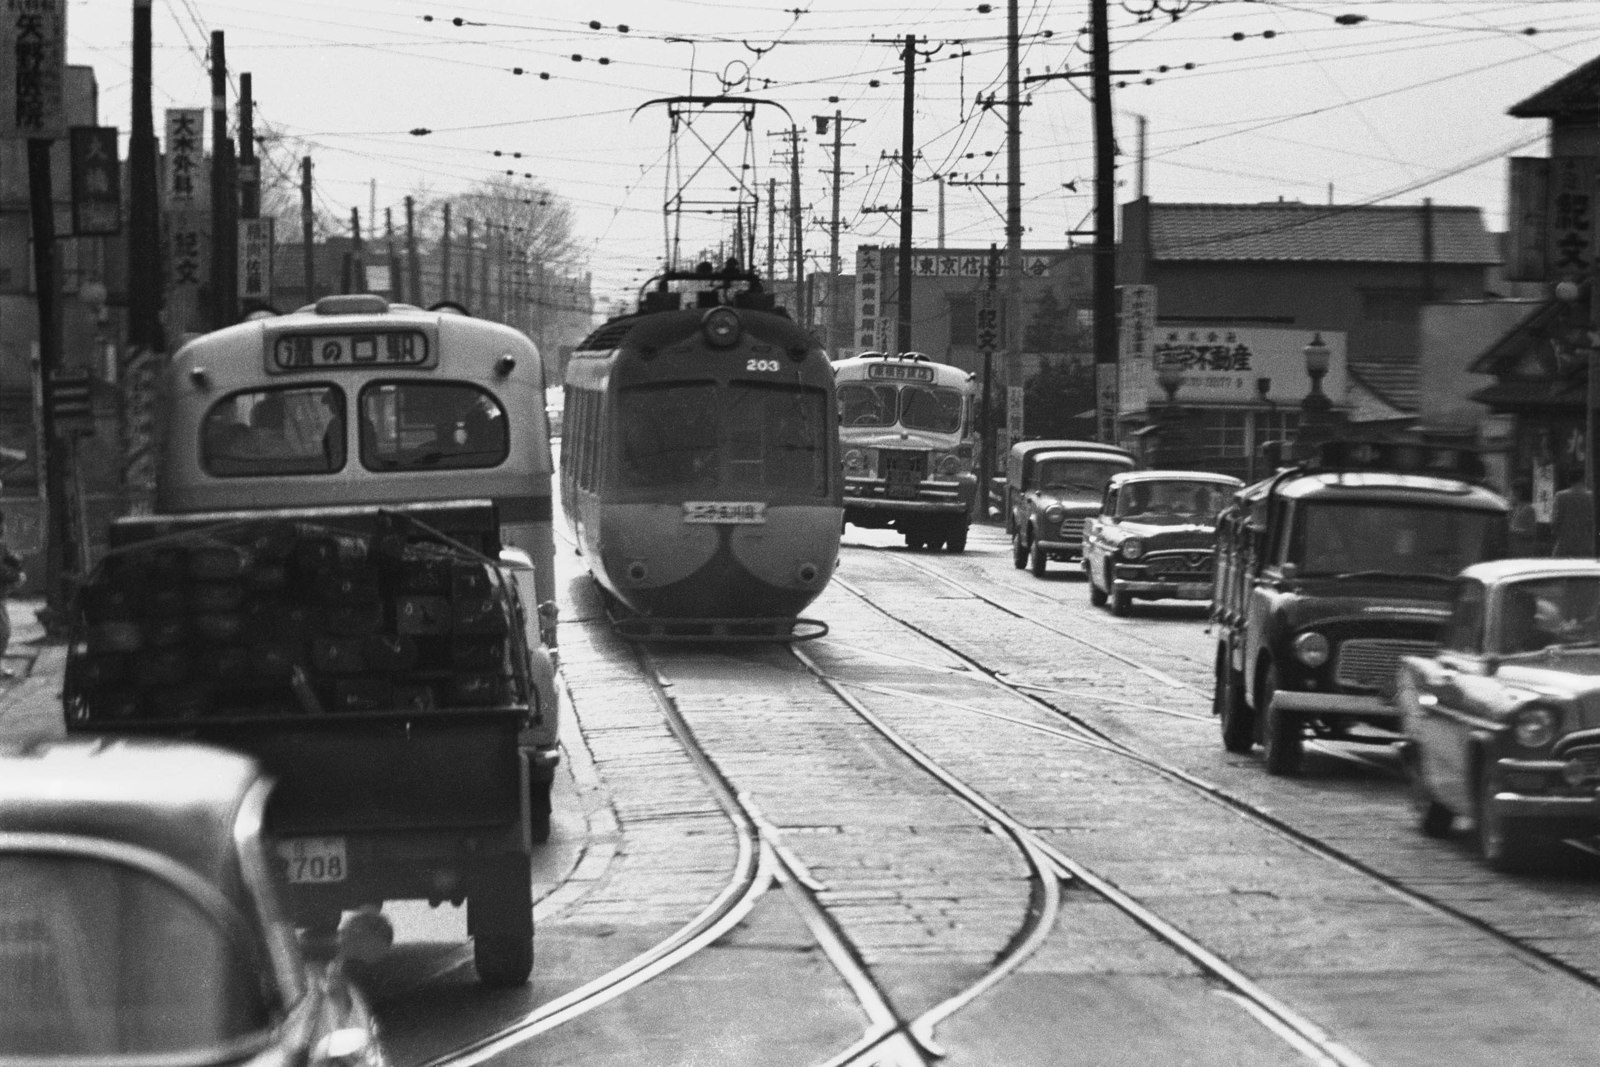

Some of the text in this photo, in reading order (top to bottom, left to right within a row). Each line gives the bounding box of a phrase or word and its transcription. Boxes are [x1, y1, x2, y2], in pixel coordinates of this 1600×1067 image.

[1555, 193, 1591, 269] 紀文
[978, 308, 998, 351] 紀文
[746, 359, 779, 372] 203
